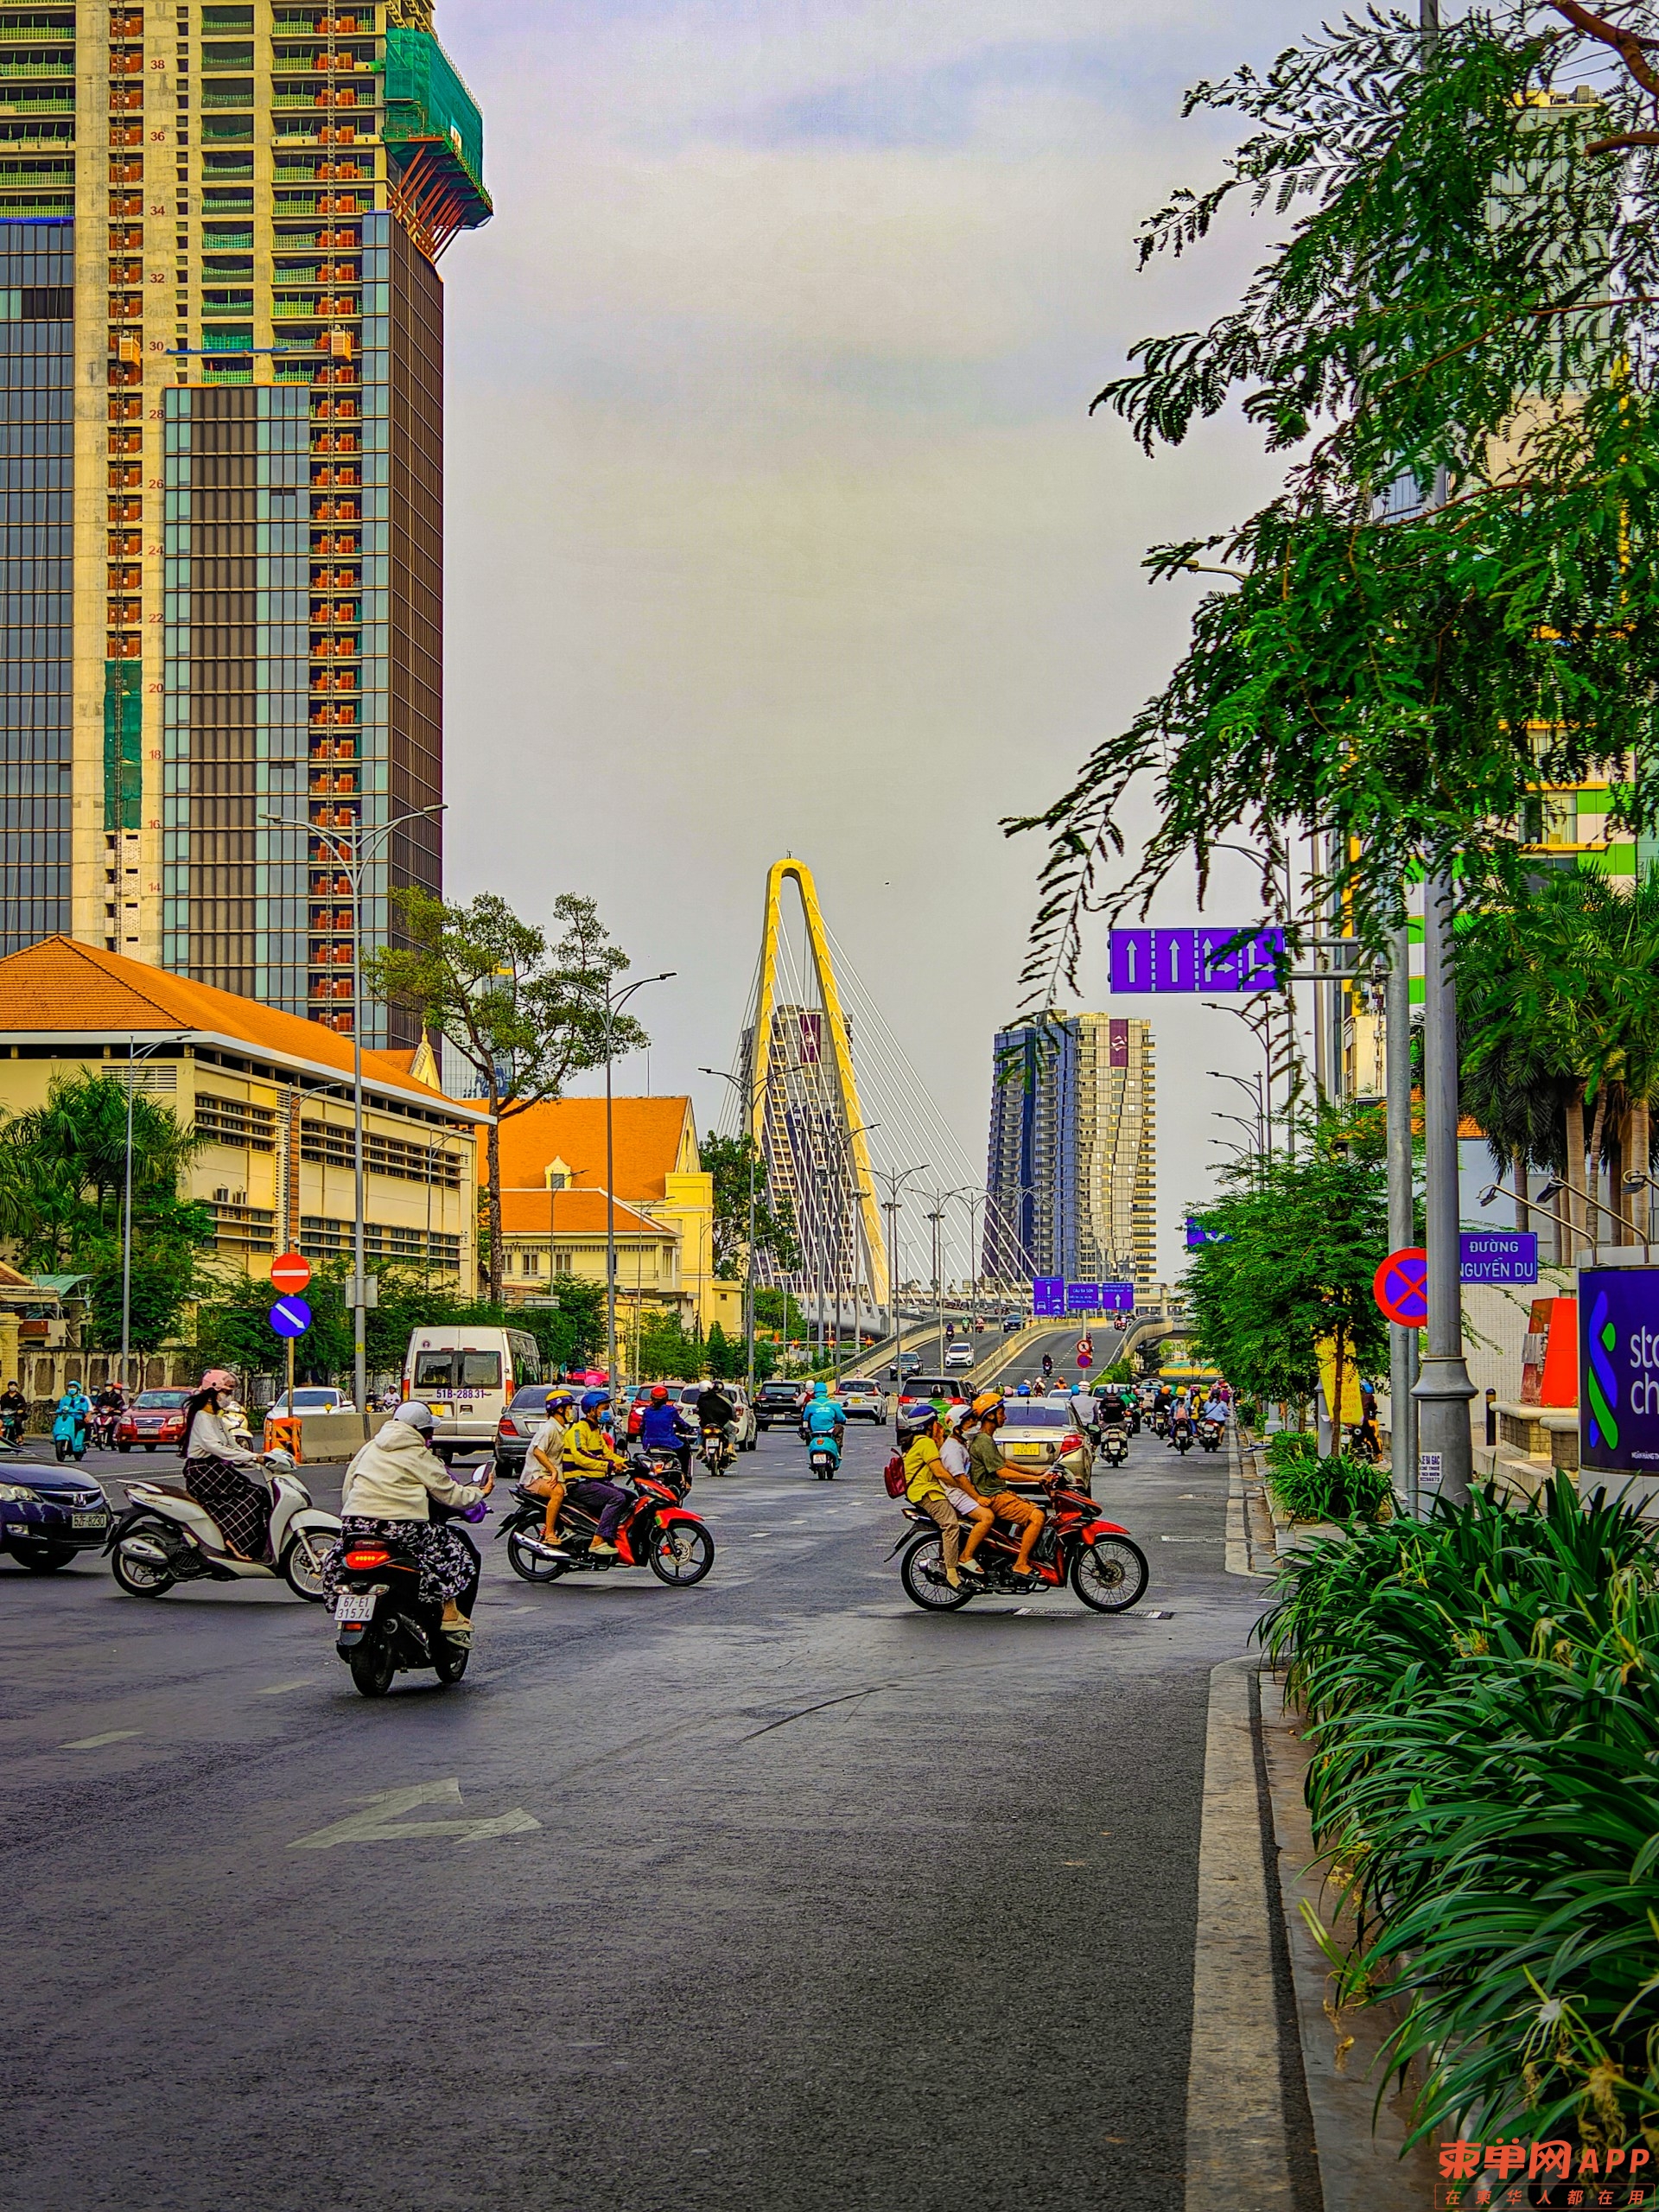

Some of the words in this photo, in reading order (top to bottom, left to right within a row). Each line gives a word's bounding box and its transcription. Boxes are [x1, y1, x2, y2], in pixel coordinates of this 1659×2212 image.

[150, 60, 165, 70] 38
[150, 131, 165, 142] 36
[149, 206, 165, 216] 34
[150, 274, 164, 283] 32
[149, 341, 163, 351] 30
[149, 410, 163, 420] 28
[149, 480, 163, 489] 26
[148, 545, 163, 555] 24
[149, 613, 163, 623] 22
[149, 683, 163, 693] 20
[149, 750, 161, 760] 18
[148, 820, 160, 830] 16
[148, 882, 161, 892] 14
[1469, 1238, 1519, 1253] ĐƯỜNG
[1515, 1262, 1534, 1278] DU
[436, 1389, 485, 1399] 51B-288.31
[344, 1597, 369, 1607] 67-E1
[337, 1608, 370, 1619] 315.74
